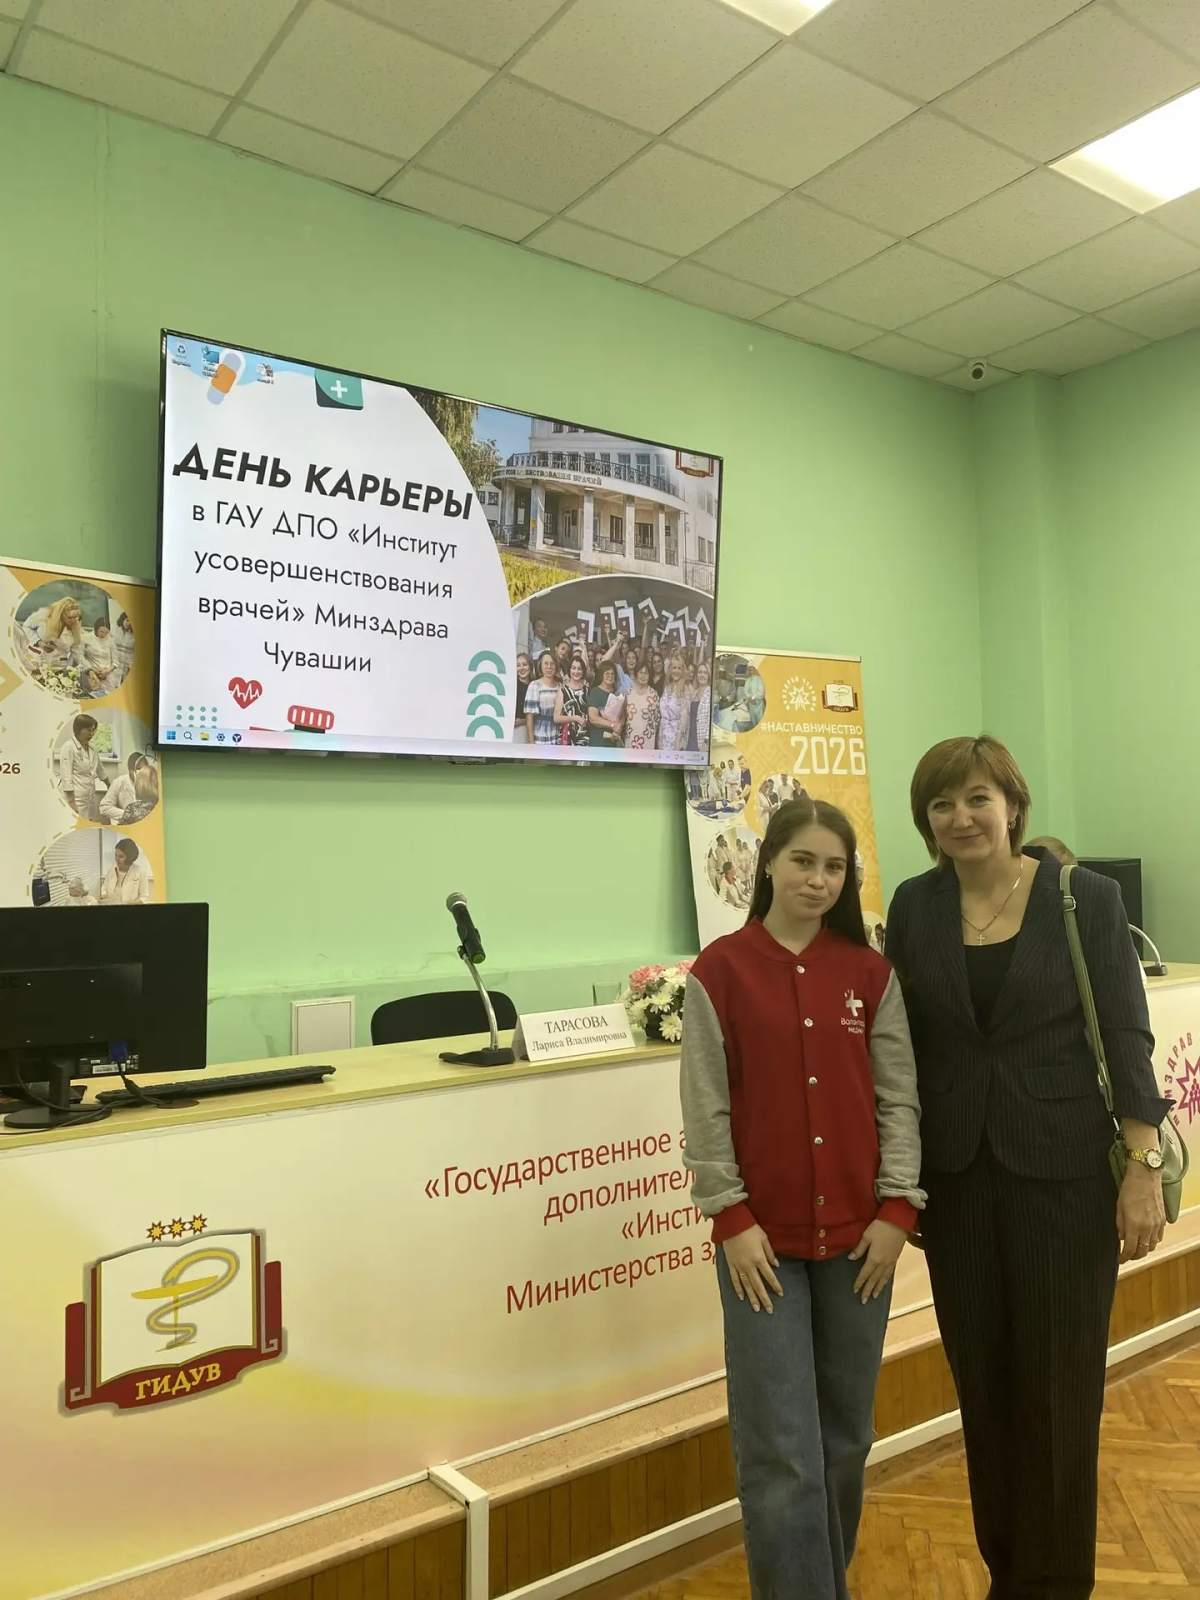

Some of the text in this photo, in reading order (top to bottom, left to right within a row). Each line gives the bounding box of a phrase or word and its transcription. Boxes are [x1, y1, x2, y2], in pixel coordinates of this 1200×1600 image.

[172, 442, 474, 520] ДЕНЬ КАРЬЕРЫ
[192, 500, 458, 563] в ГАУ ДПО «Институт
[194, 550, 453, 599] усовершенствования
[198, 597, 449, 640] врачей» Минздрава
[264, 641, 371, 673] Чувашии
[760, 721, 863, 736] #НАСТАВНИЧЕСТВО
[0, 762, 21, 775] 26
[790, 735, 867, 776] 2026
[532, 1031, 628, 1052] Лариса Владимировна
[544, 1014, 609, 1034] ТАРАСОВА
[424, 1132, 671, 1199] «Государственное
[506, 1246, 694, 1314] Министерства
[135, 1362, 222, 1400] ГИДУВ
